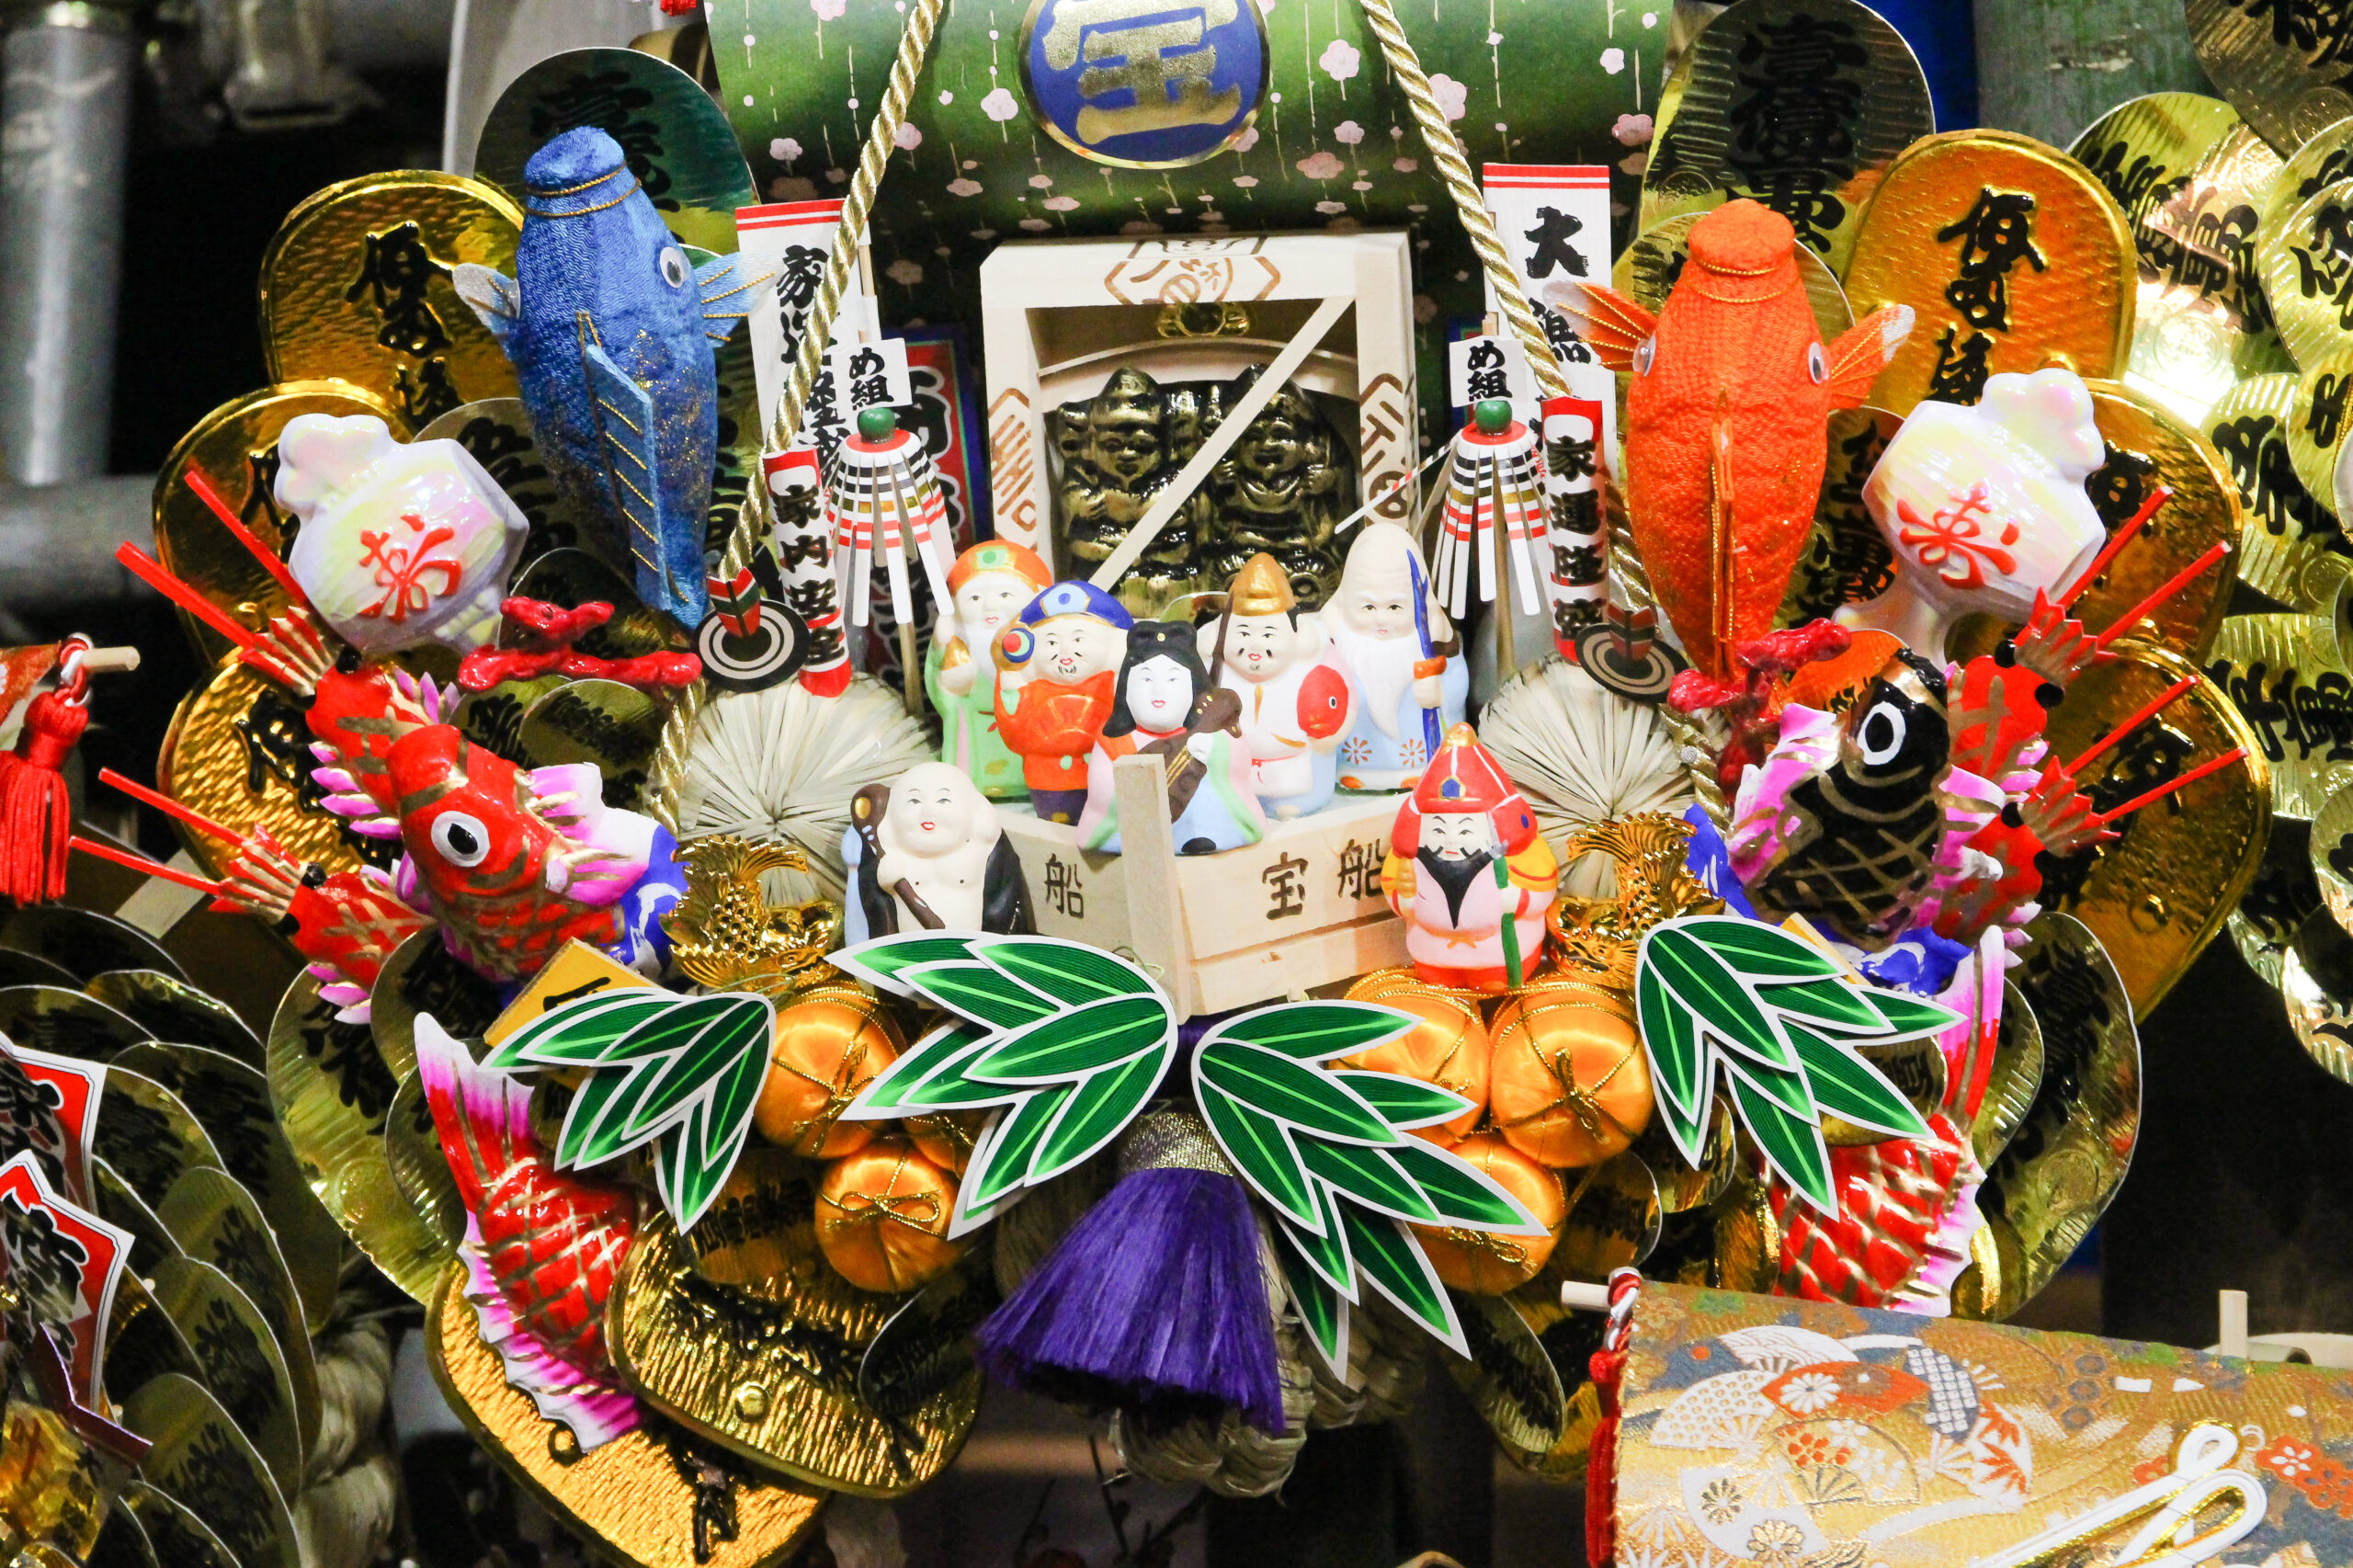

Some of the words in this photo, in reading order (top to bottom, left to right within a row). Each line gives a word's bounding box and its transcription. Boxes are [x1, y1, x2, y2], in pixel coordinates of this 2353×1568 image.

[849, 347, 894, 410] め組
[1467, 339, 1513, 402] め組
[1044, 853, 1085, 919] 船
[1262, 838, 1385, 920] 宝船
